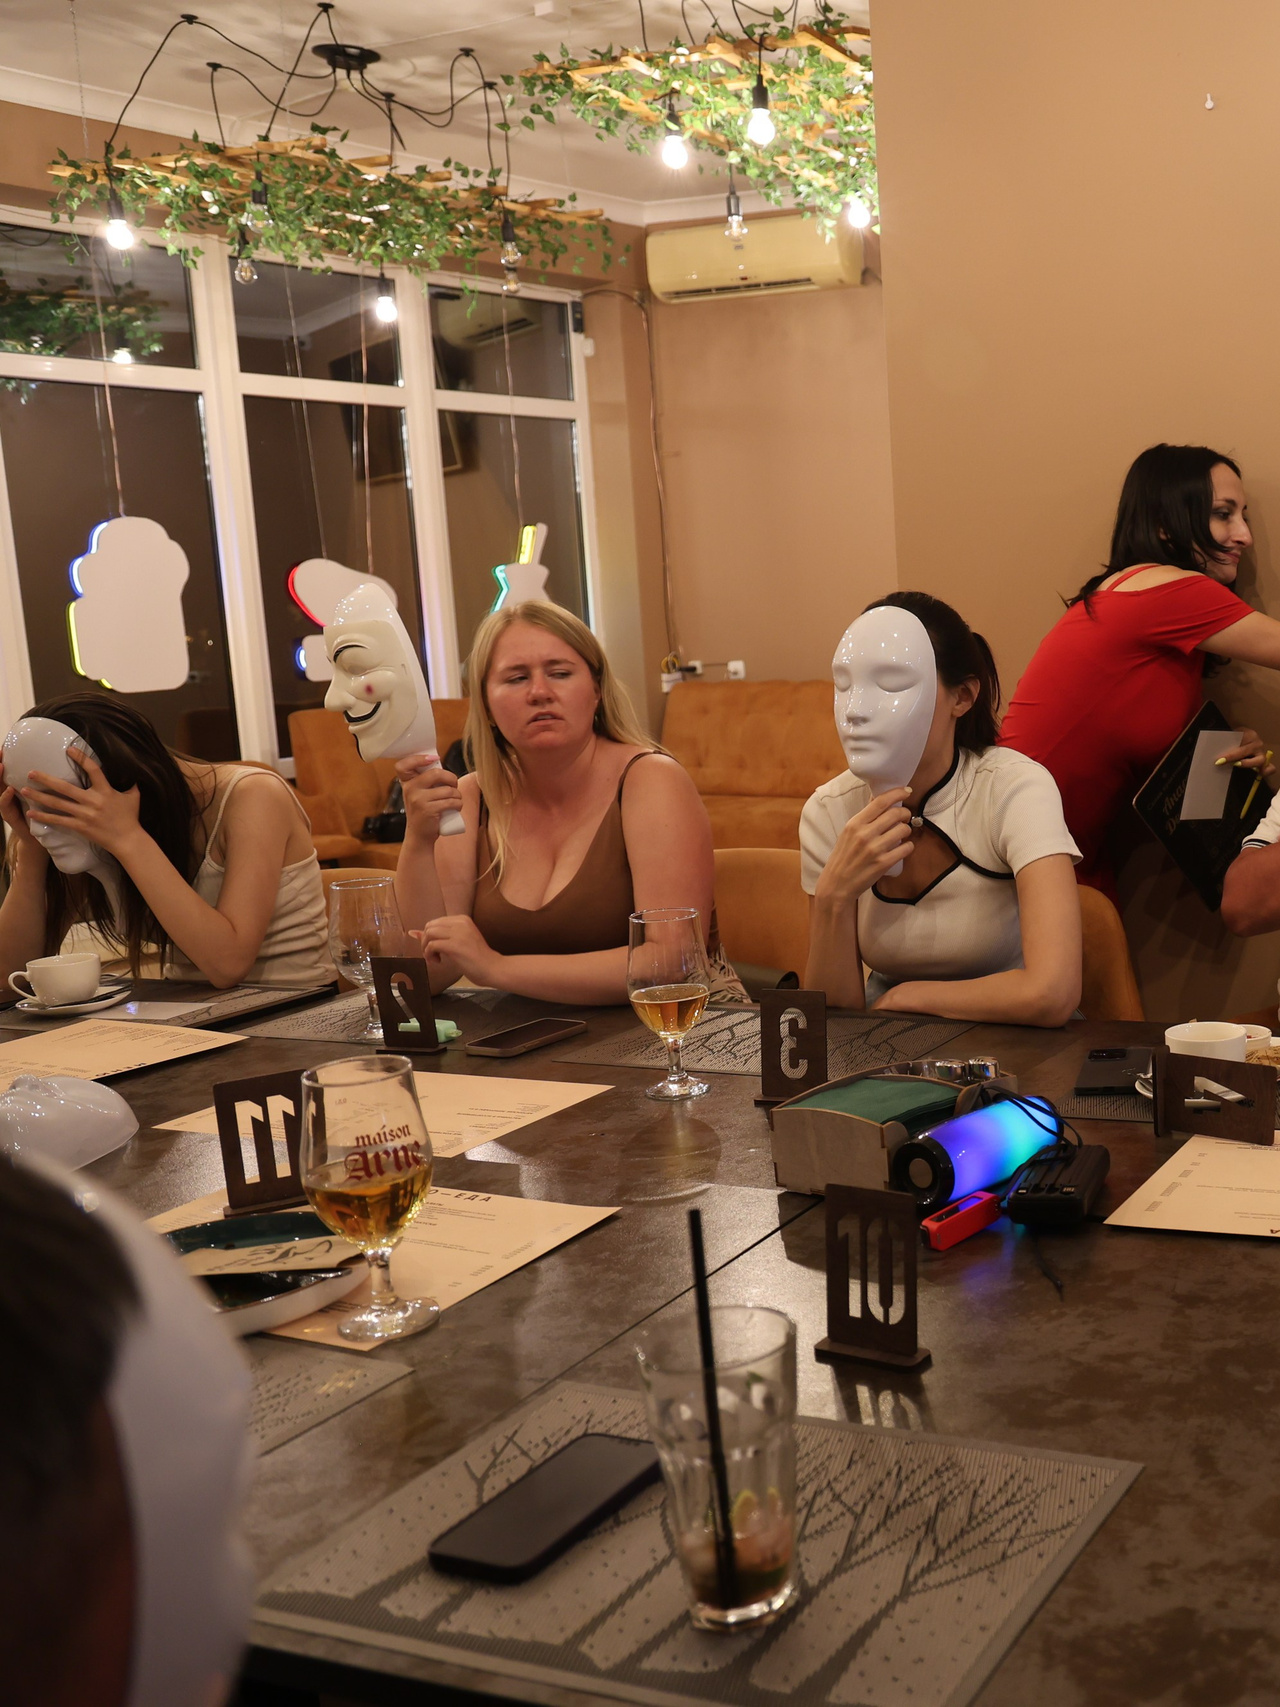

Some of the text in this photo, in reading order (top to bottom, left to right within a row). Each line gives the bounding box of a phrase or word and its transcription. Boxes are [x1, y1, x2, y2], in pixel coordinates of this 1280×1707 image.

[355, 1124, 411, 1148] maison
[344, 1140, 423, 1181] Arne
[836, 1212, 907, 1325] 10
